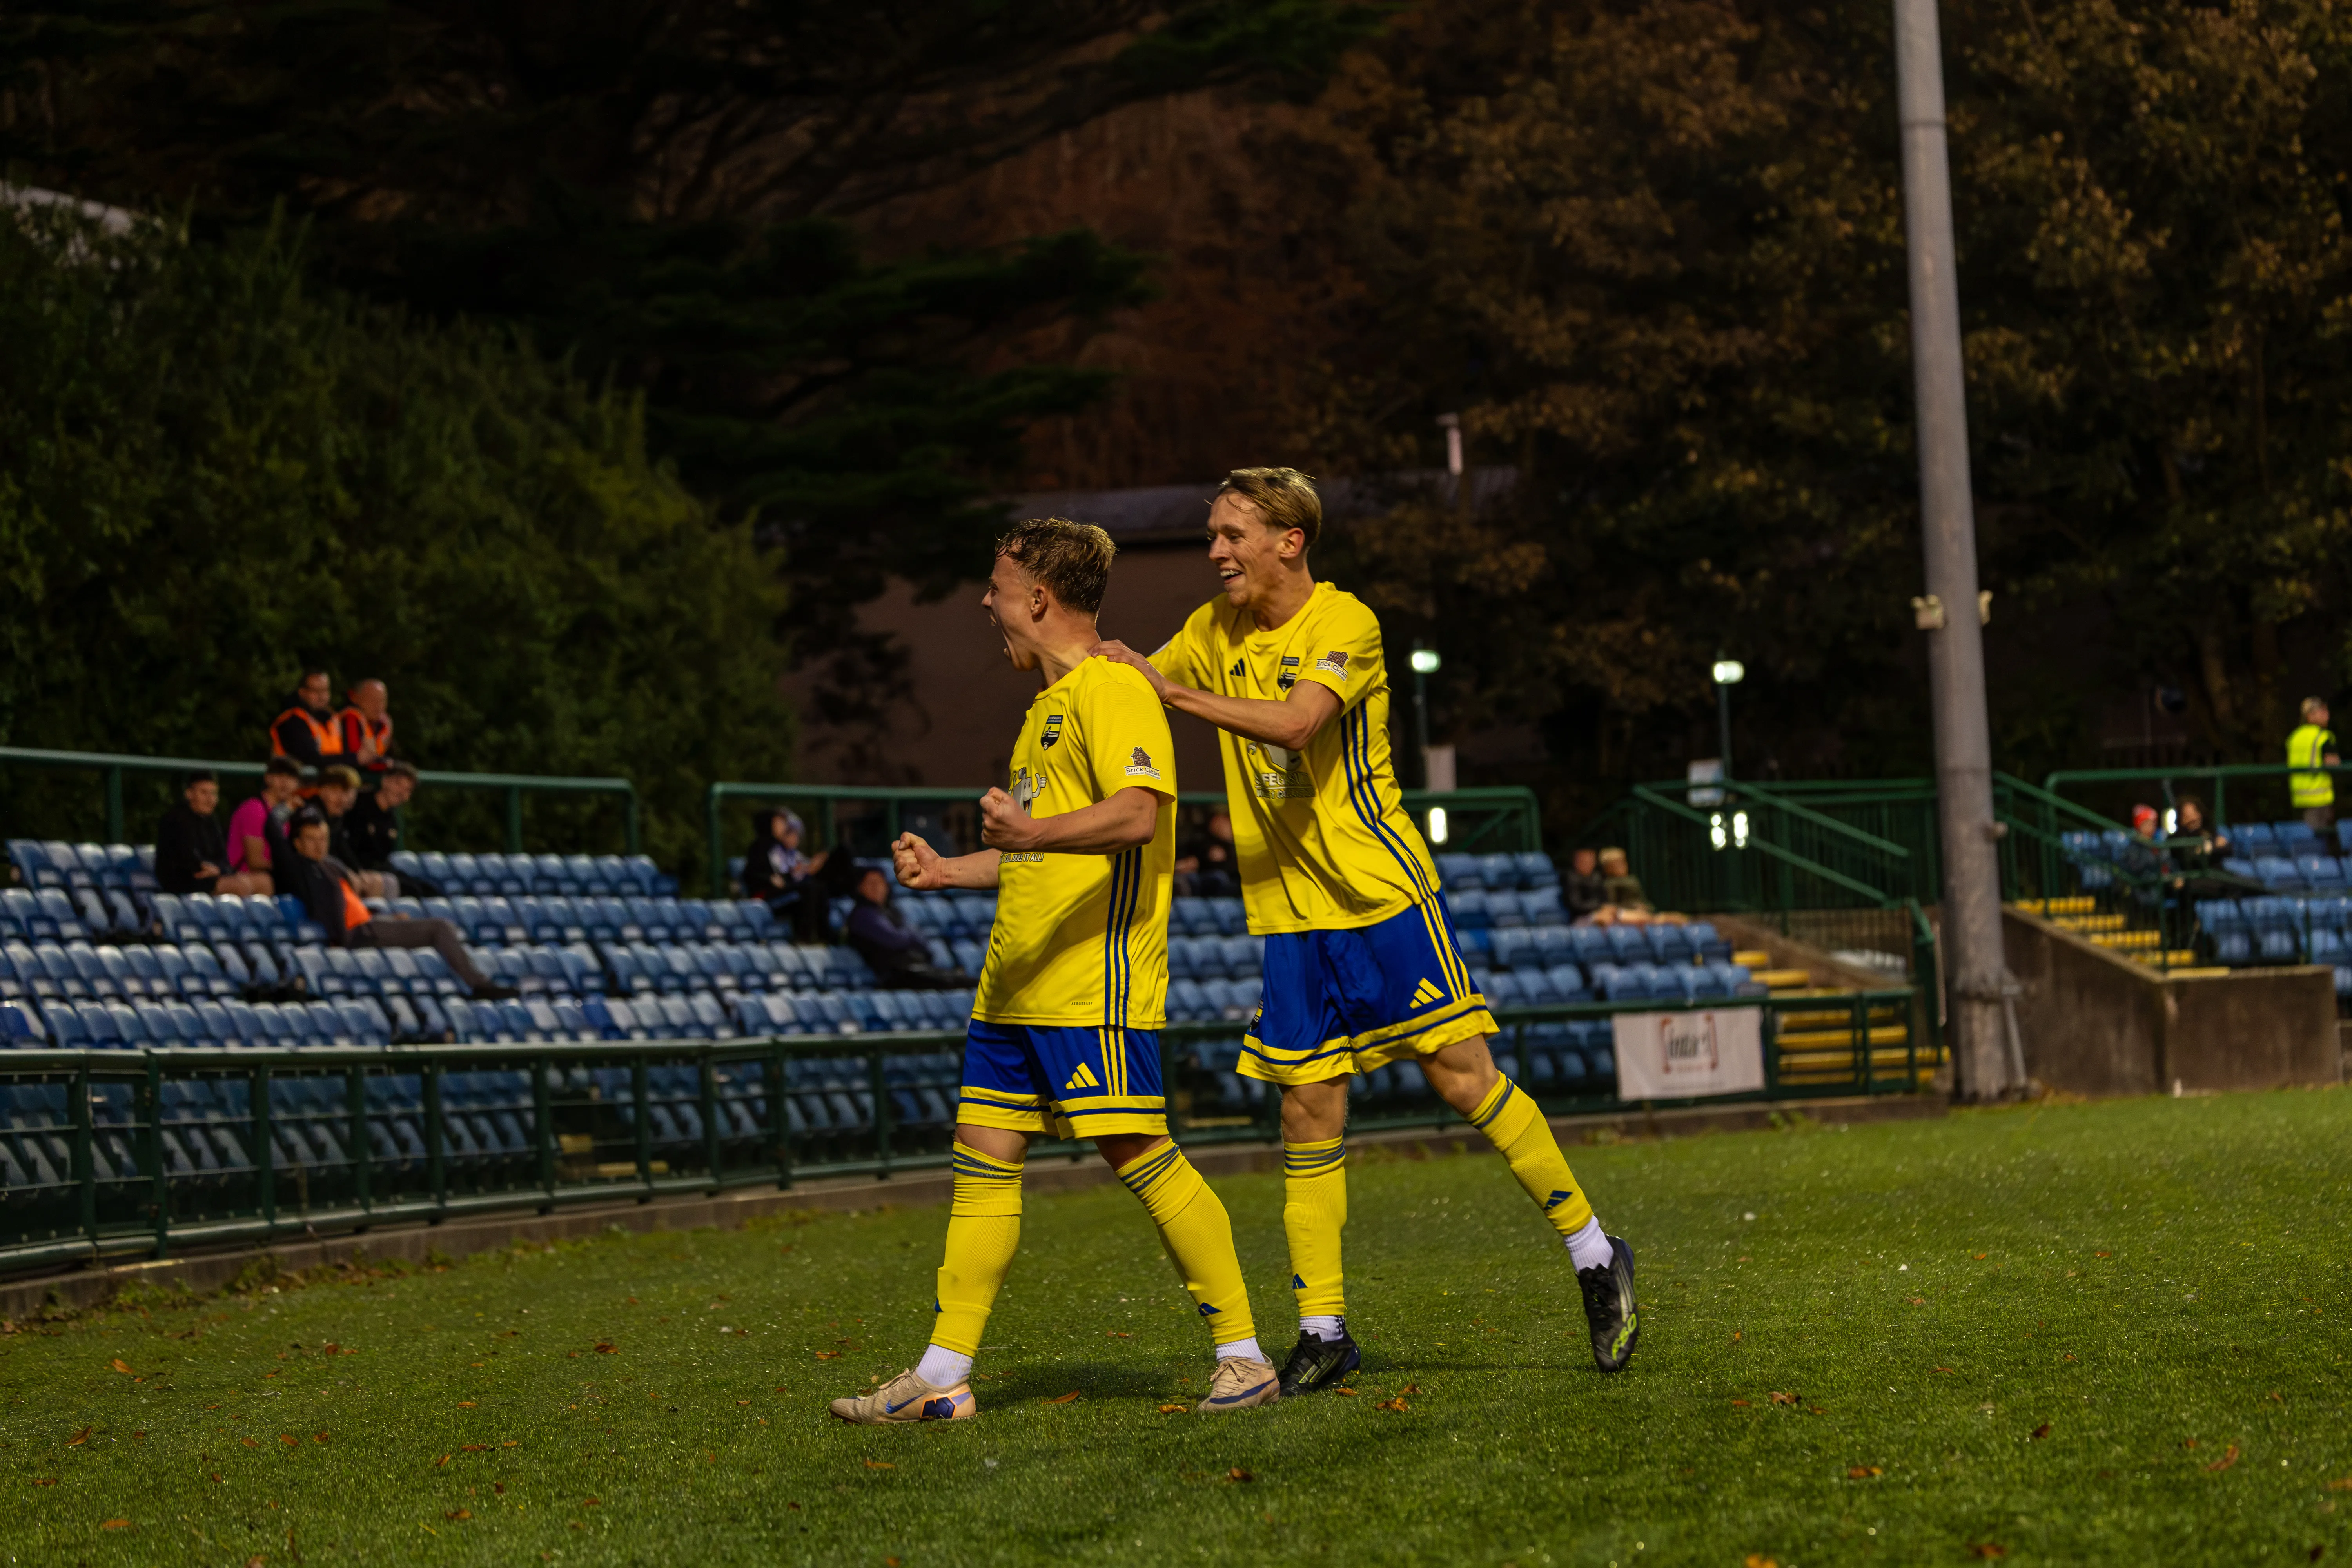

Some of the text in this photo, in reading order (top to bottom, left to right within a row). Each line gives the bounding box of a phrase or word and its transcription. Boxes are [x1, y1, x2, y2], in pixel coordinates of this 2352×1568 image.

[1333, 664, 1347, 678] Clean
[1145, 767, 1160, 777] Clean
[1012, 854, 1023, 862] DOES
[1023, 853, 1031, 862] IT
[1029, 853, 1044, 862] ALL!
